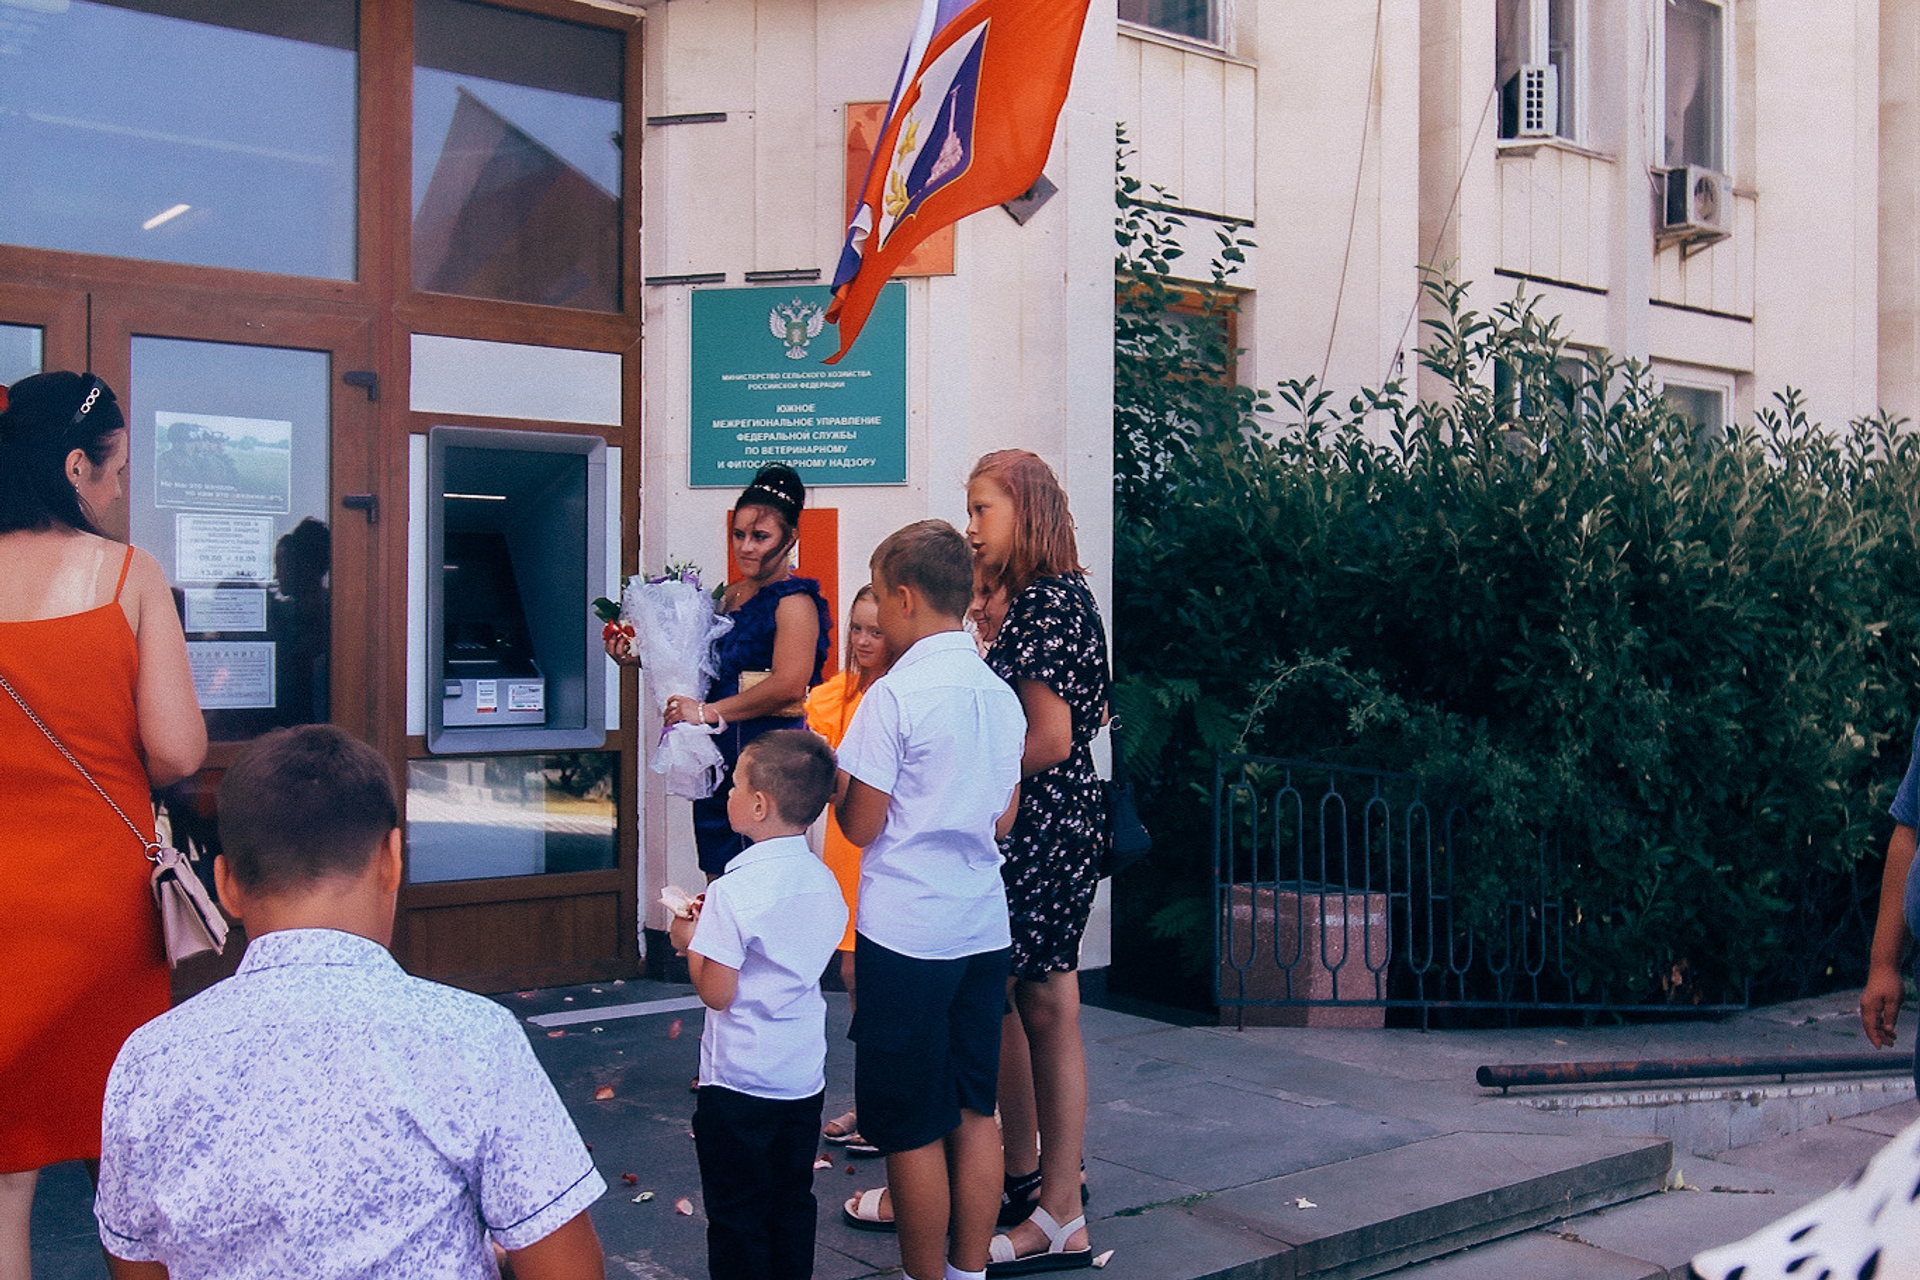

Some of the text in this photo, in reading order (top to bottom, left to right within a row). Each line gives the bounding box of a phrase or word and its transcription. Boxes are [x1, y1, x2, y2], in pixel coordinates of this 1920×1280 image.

[721, 370, 872, 381] МИНИСТЕРСТВО СЕЛЬСКОГО ХОЗЯЙСТВА
[748, 381, 846, 391] РОССИЙСКОЙ ФЕДЕРАЦИИ
[776, 403, 816, 413] ЮЖНОЕ
[712, 416, 882, 428] МЕЖРЕГИОНАЛЬНОЕ УПРАВЛЕНИЕ
[736, 430, 857, 442] ФЕДЕРАЛЬНОЙ СЛУЖБЫ
[744, 445, 848, 455] ПО ВЕТЕРИНАРНОМУ
[717, 458, 877, 469] И ФИТОСАТАРНОМУ НАДЗОРУ
